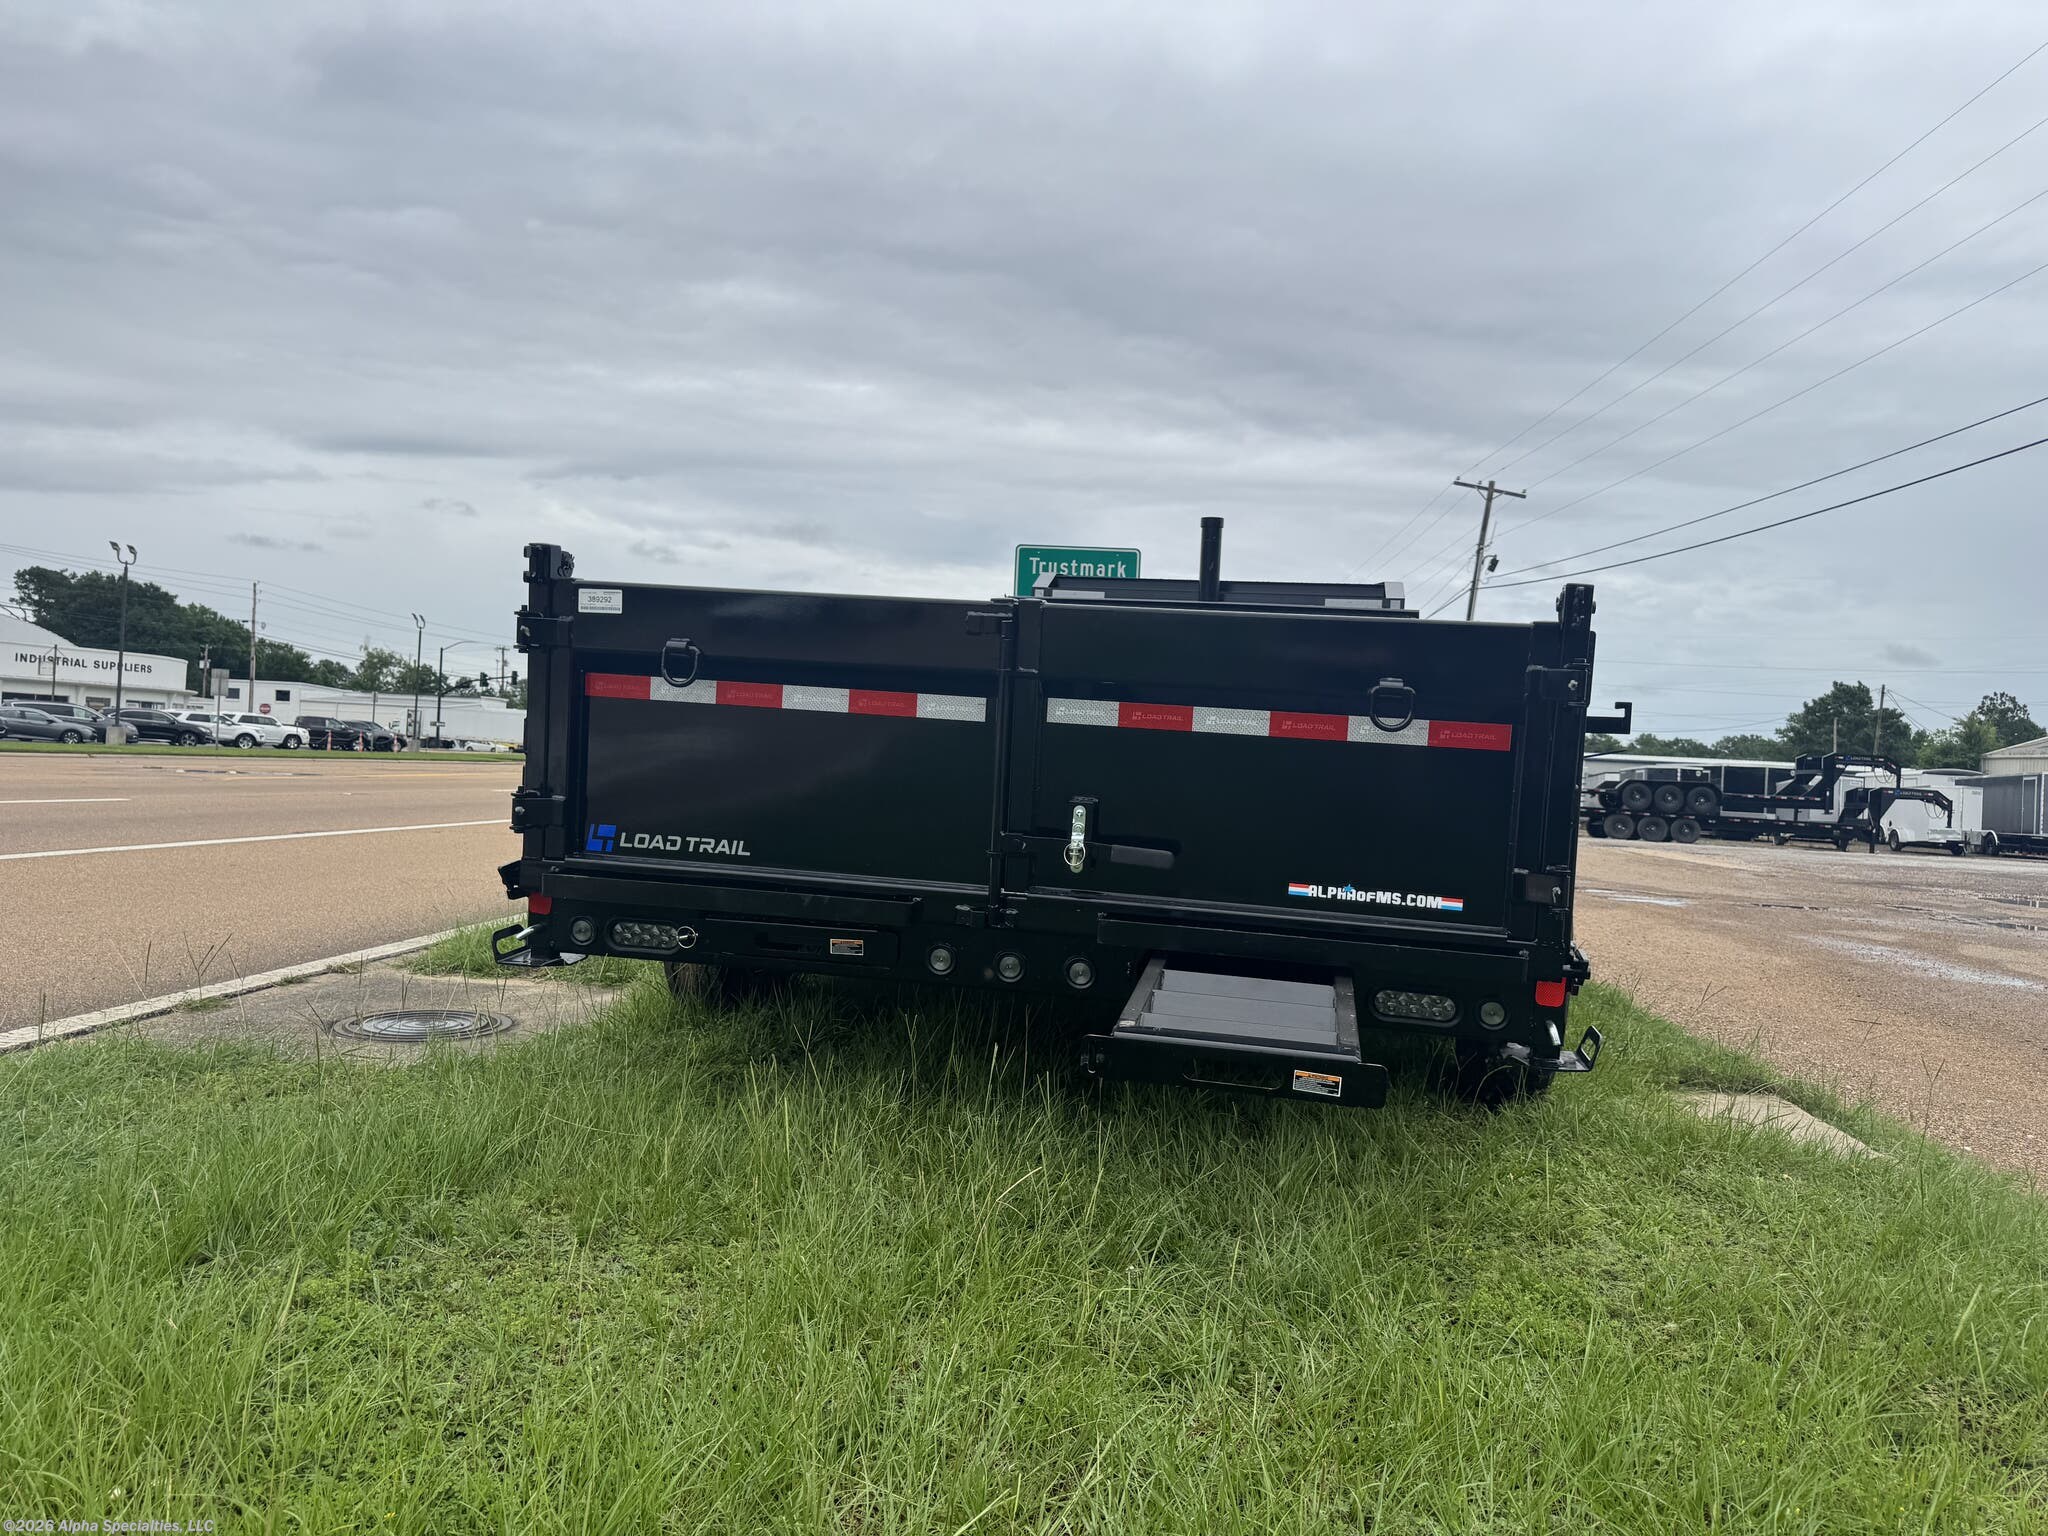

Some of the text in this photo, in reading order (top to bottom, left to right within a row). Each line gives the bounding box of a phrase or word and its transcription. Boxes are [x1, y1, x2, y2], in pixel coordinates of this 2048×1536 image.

[1029, 557, 1127, 578] Trustmark
[15, 652, 88, 668] INDUSTRIAL
[619, 832, 751, 856] LOAD TRAIL
